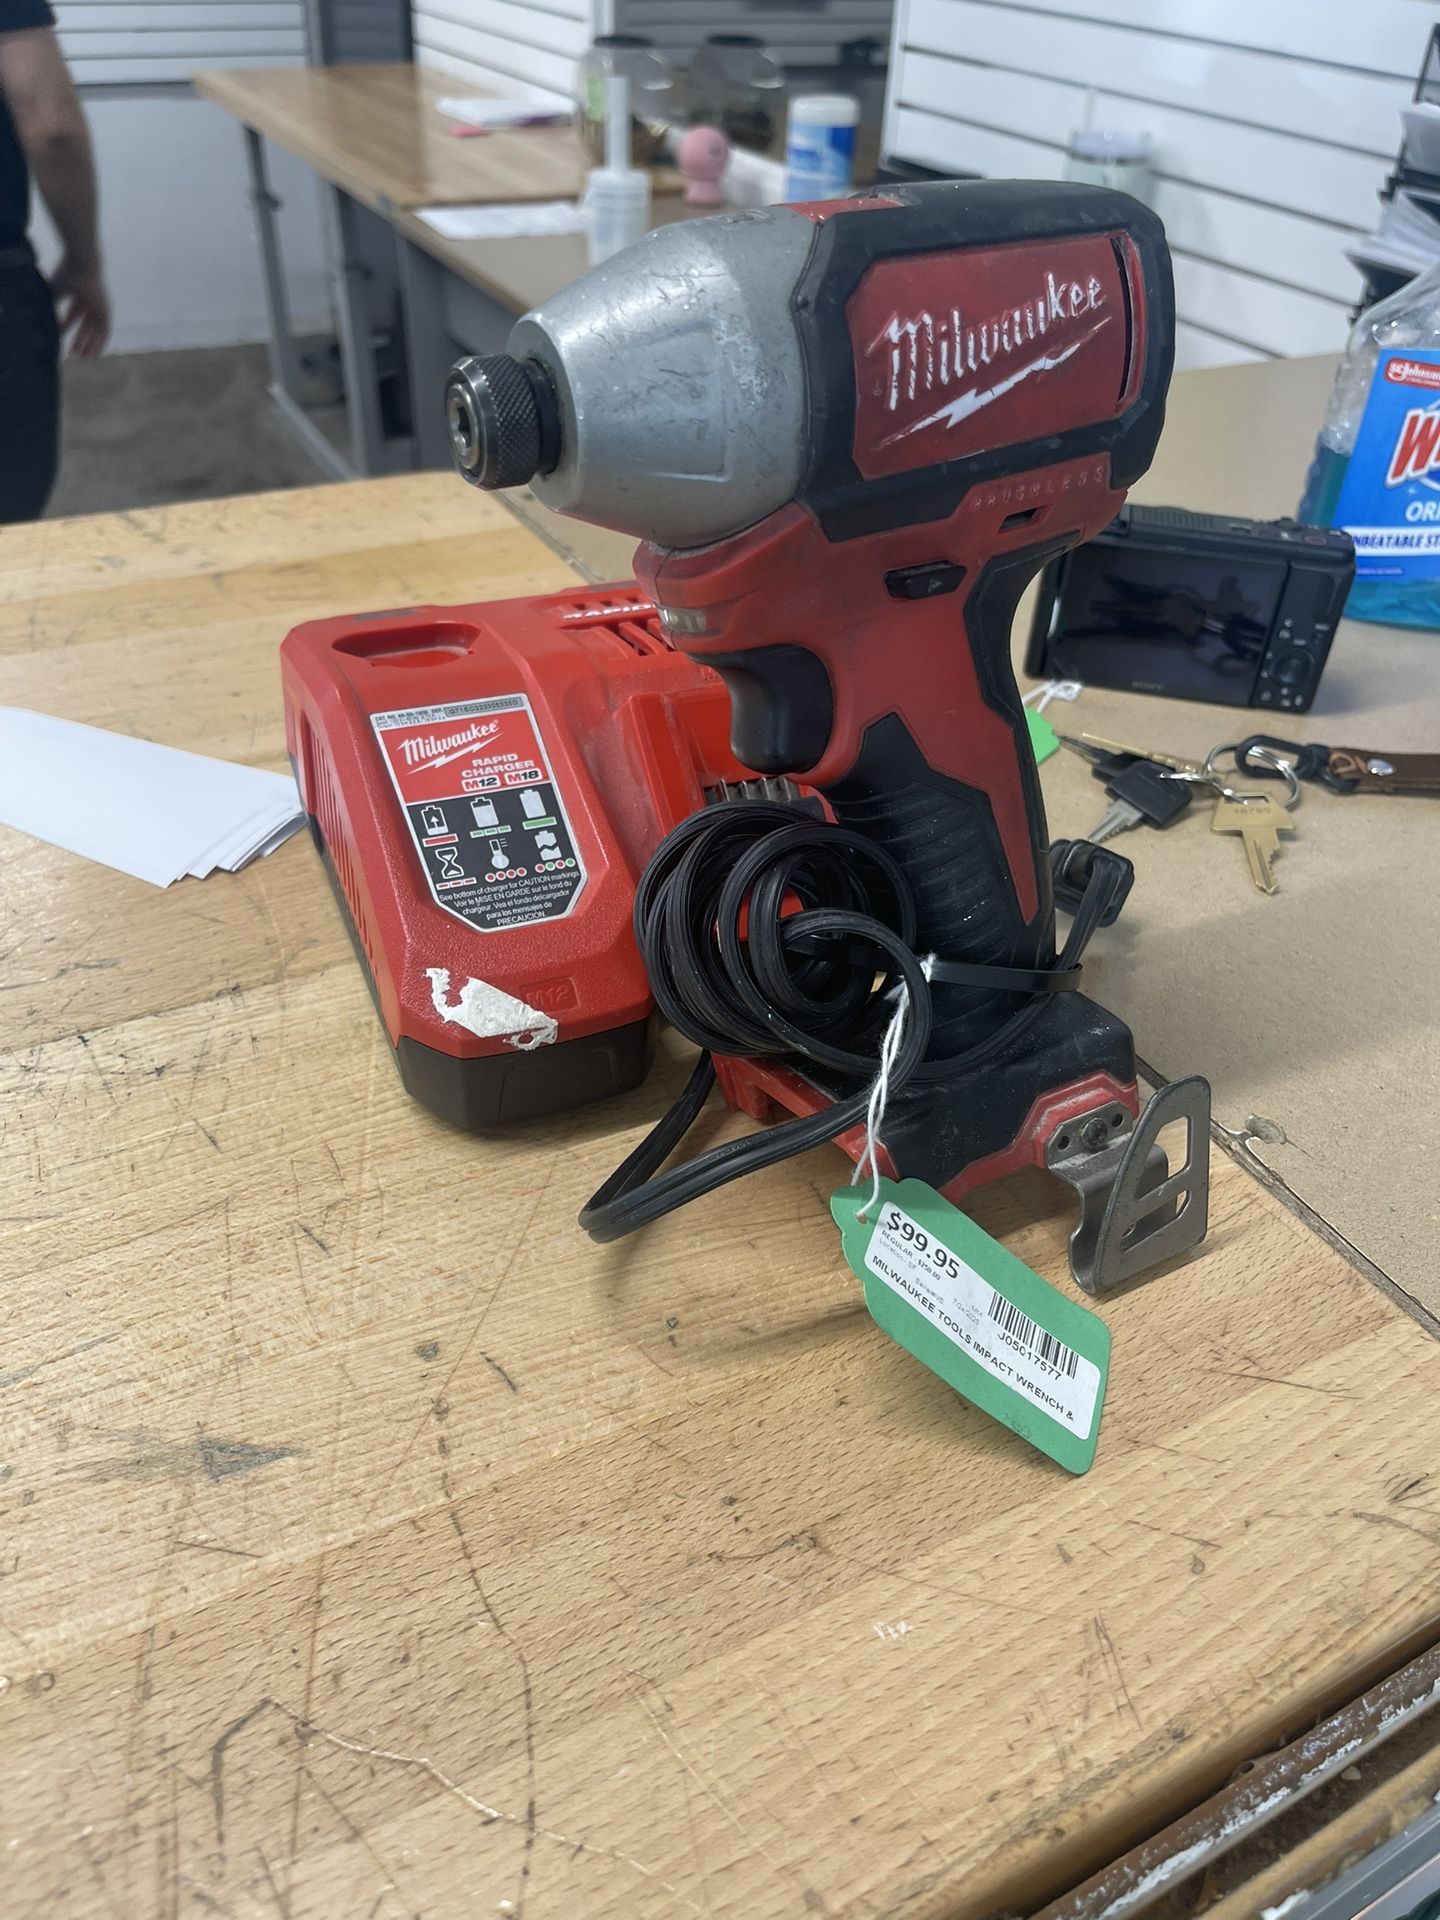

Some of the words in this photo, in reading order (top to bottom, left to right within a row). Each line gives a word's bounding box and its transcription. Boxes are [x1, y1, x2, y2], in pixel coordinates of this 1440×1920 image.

[866, 271, 1107, 411] Milwaukee
[972, 465, 1103, 510] BRUSHLESS
[1353, 533, 1422, 549] NBEATABLE
[397, 723, 499, 766] Milwaukee
[461, 760, 535, 778] CHARGER
[472, 753, 519, 768] RAPID
[464, 776, 498, 790] M12
[507, 770, 540, 783] M18
[439, 893, 453, 902] See
[453, 888, 477, 900] bottom
[484, 883, 509, 895] charger
[509, 881, 519, 890] for
[518, 875, 551, 888] CAUTION
[453, 898, 467, 908] Voir
[475, 893, 494, 905] MISE
[494, 891, 506, 901] EN
[505, 887, 531, 899] GARDE
[531, 885, 542, 893] sur
[549, 881, 563, 890] fond
[563, 880, 572, 888] du
[493, 900, 507, 910] Vea
[513, 895, 533, 906] fondo
[486, 908, 501, 920] para
[501, 906, 512, 916] los
[512, 903, 543, 916] mensajes
[543, 901, 552, 910] de
[881, 1230, 913, 1258] REGULAR
[886, 1212, 960, 1279] $99.95
[872, 1255, 936, 1314] MILWAUKEE
[938, 1309, 972, 1345] TOOLS
[972, 1341, 1014, 1376] IMPACT
[1016, 1372, 1064, 1414] WRENCH
[1065, 1410, 1075, 1422] &
[997, 1331, 1062, 1381] J05017577
